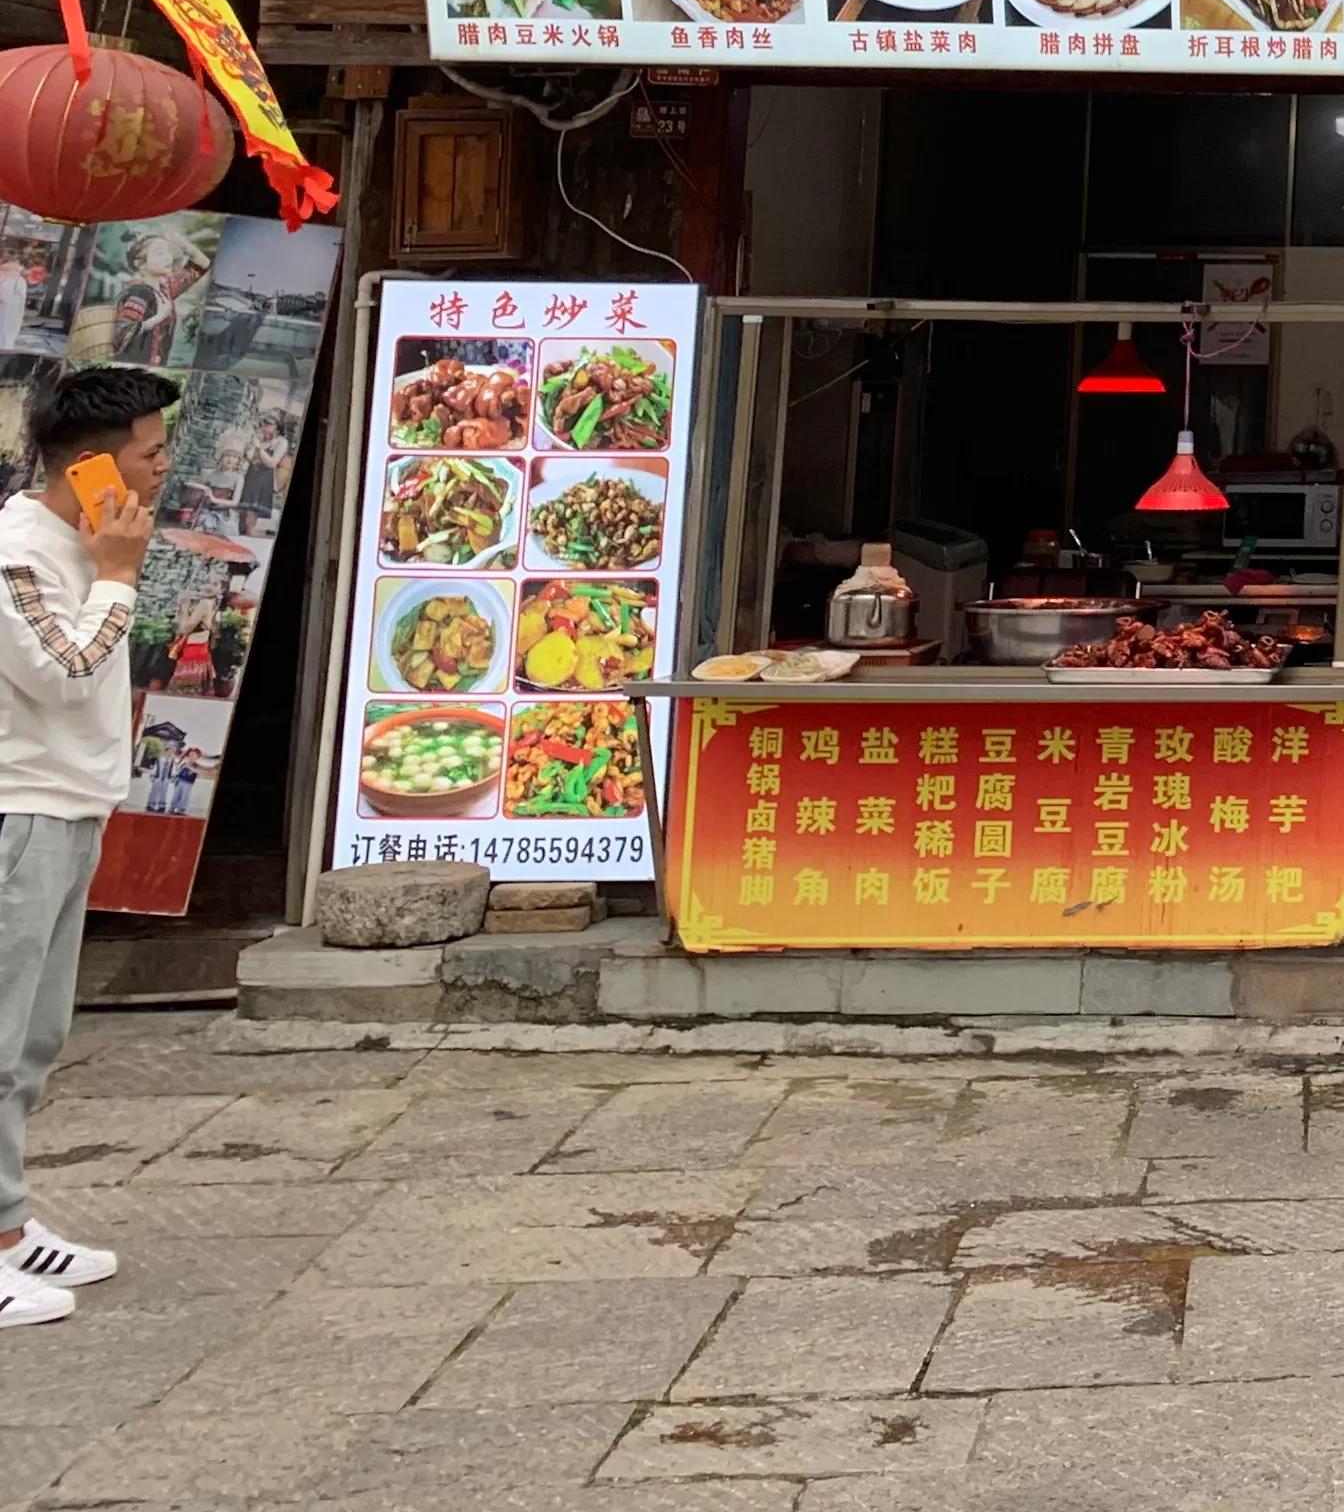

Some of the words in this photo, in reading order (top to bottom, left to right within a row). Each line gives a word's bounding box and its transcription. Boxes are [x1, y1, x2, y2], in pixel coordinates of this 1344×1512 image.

[457, 22, 620, 50] 腊肉豆米火锅
[671, 26, 774, 52] 鱼香肉丝
[848, 28, 977, 54] 古镇盐菜肉
[1039, 32, 1141, 58] 腊肉拼盘
[1187, 34, 1339, 62] 折耳根炒腊肉
[428, 289, 648, 334] 特色炒菜
[738, 725, 785, 907] 铜锅卤猪脚
[793, 728, 842, 904] 鸡辣角
[853, 727, 901, 904] 盐菜肉
[911, 727, 960, 905] 糕粑稀饭
[970, 728, 1018, 904] 豆腐圆子
[1028, 727, 1077, 903] 米豆腐
[1088, 726, 1136, 903] 青岩豆腐
[1147, 726, 1195, 903] 玫瑰冰粉
[1207, 726, 1254, 902] 酸梅汤
[1264, 725, 1311, 903] 洋芋粑
